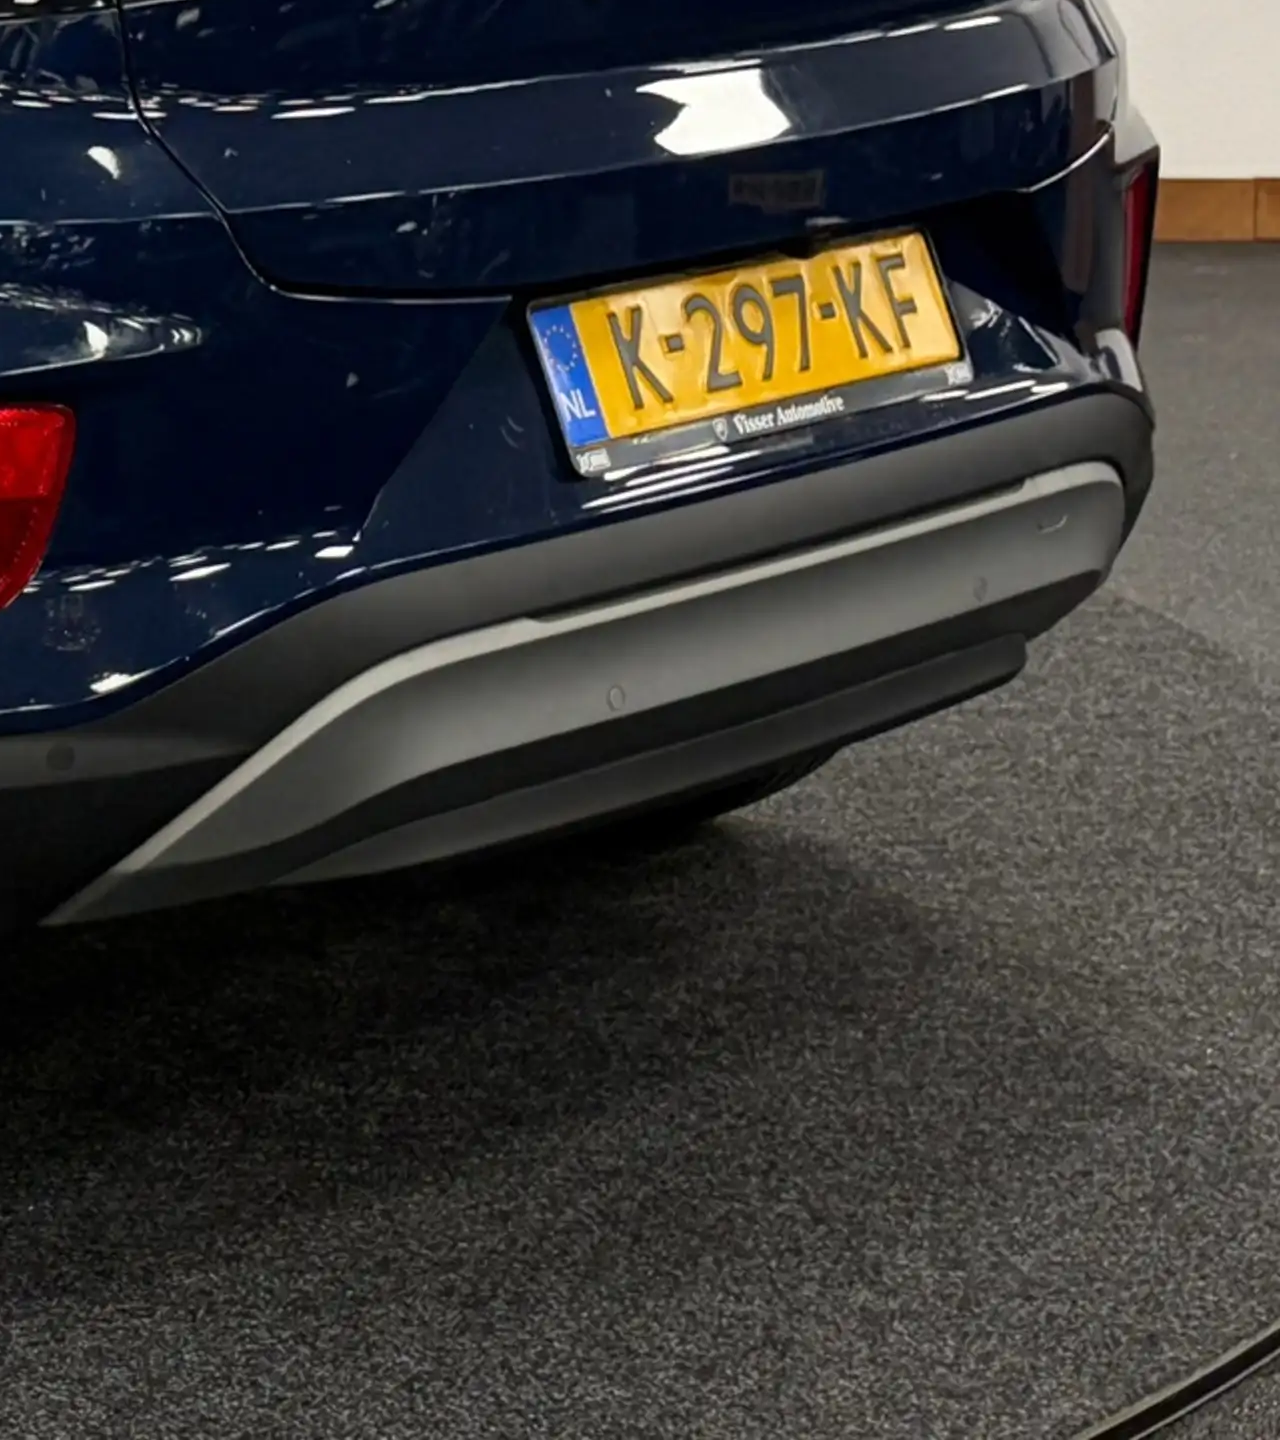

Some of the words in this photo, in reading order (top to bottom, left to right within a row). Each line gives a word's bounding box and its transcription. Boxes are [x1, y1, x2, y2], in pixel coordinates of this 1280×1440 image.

[605, 252, 918, 410] K-297-KF
[559, 391, 596, 423] NL
[733, 412, 775, 435] Visser
[776, 392, 845, 426] Automotive
